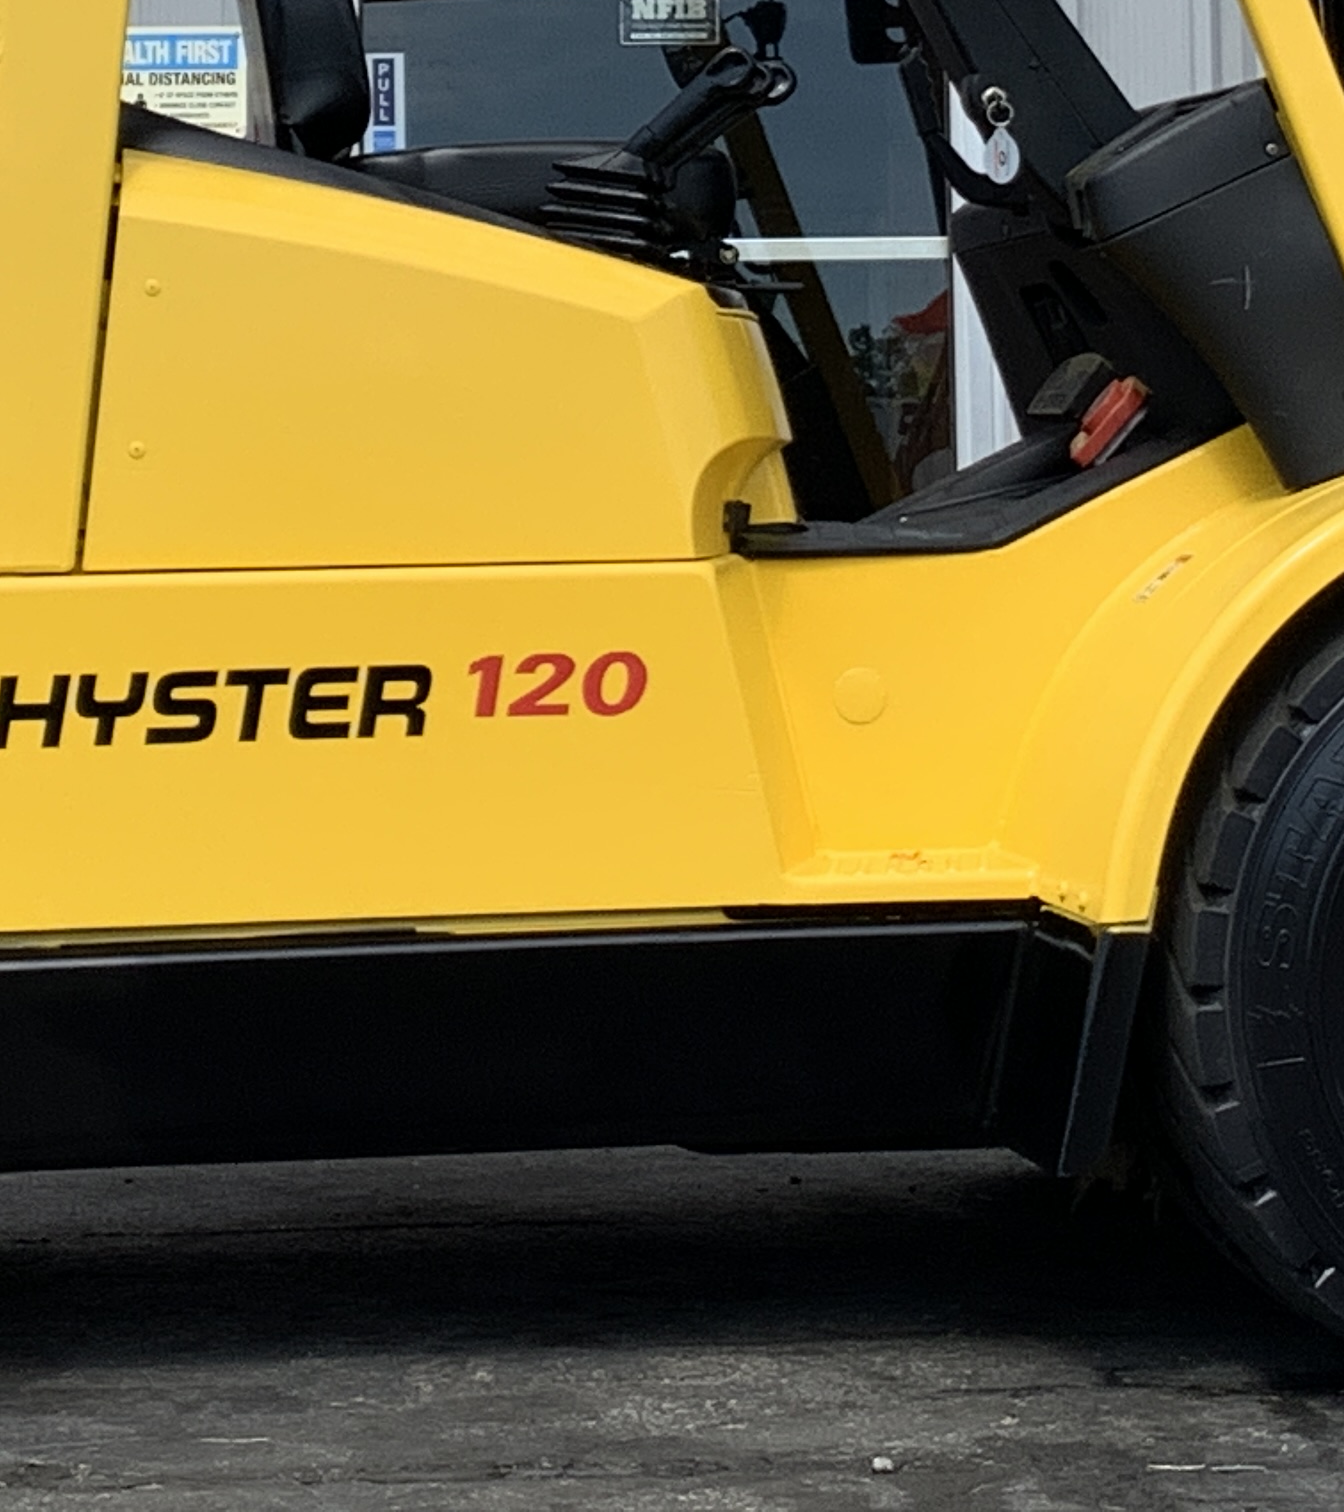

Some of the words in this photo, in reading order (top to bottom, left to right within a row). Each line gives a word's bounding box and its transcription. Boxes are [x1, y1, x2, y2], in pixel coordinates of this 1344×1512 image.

[124, 39, 169, 65] ALTH
[175, 39, 232, 65] FIRST
[120, 72, 144, 86] IAL
[149, 71, 236, 86] DISTANCING
[377, 62, 390, 121] PULL
[468, 651, 648, 718] 120
